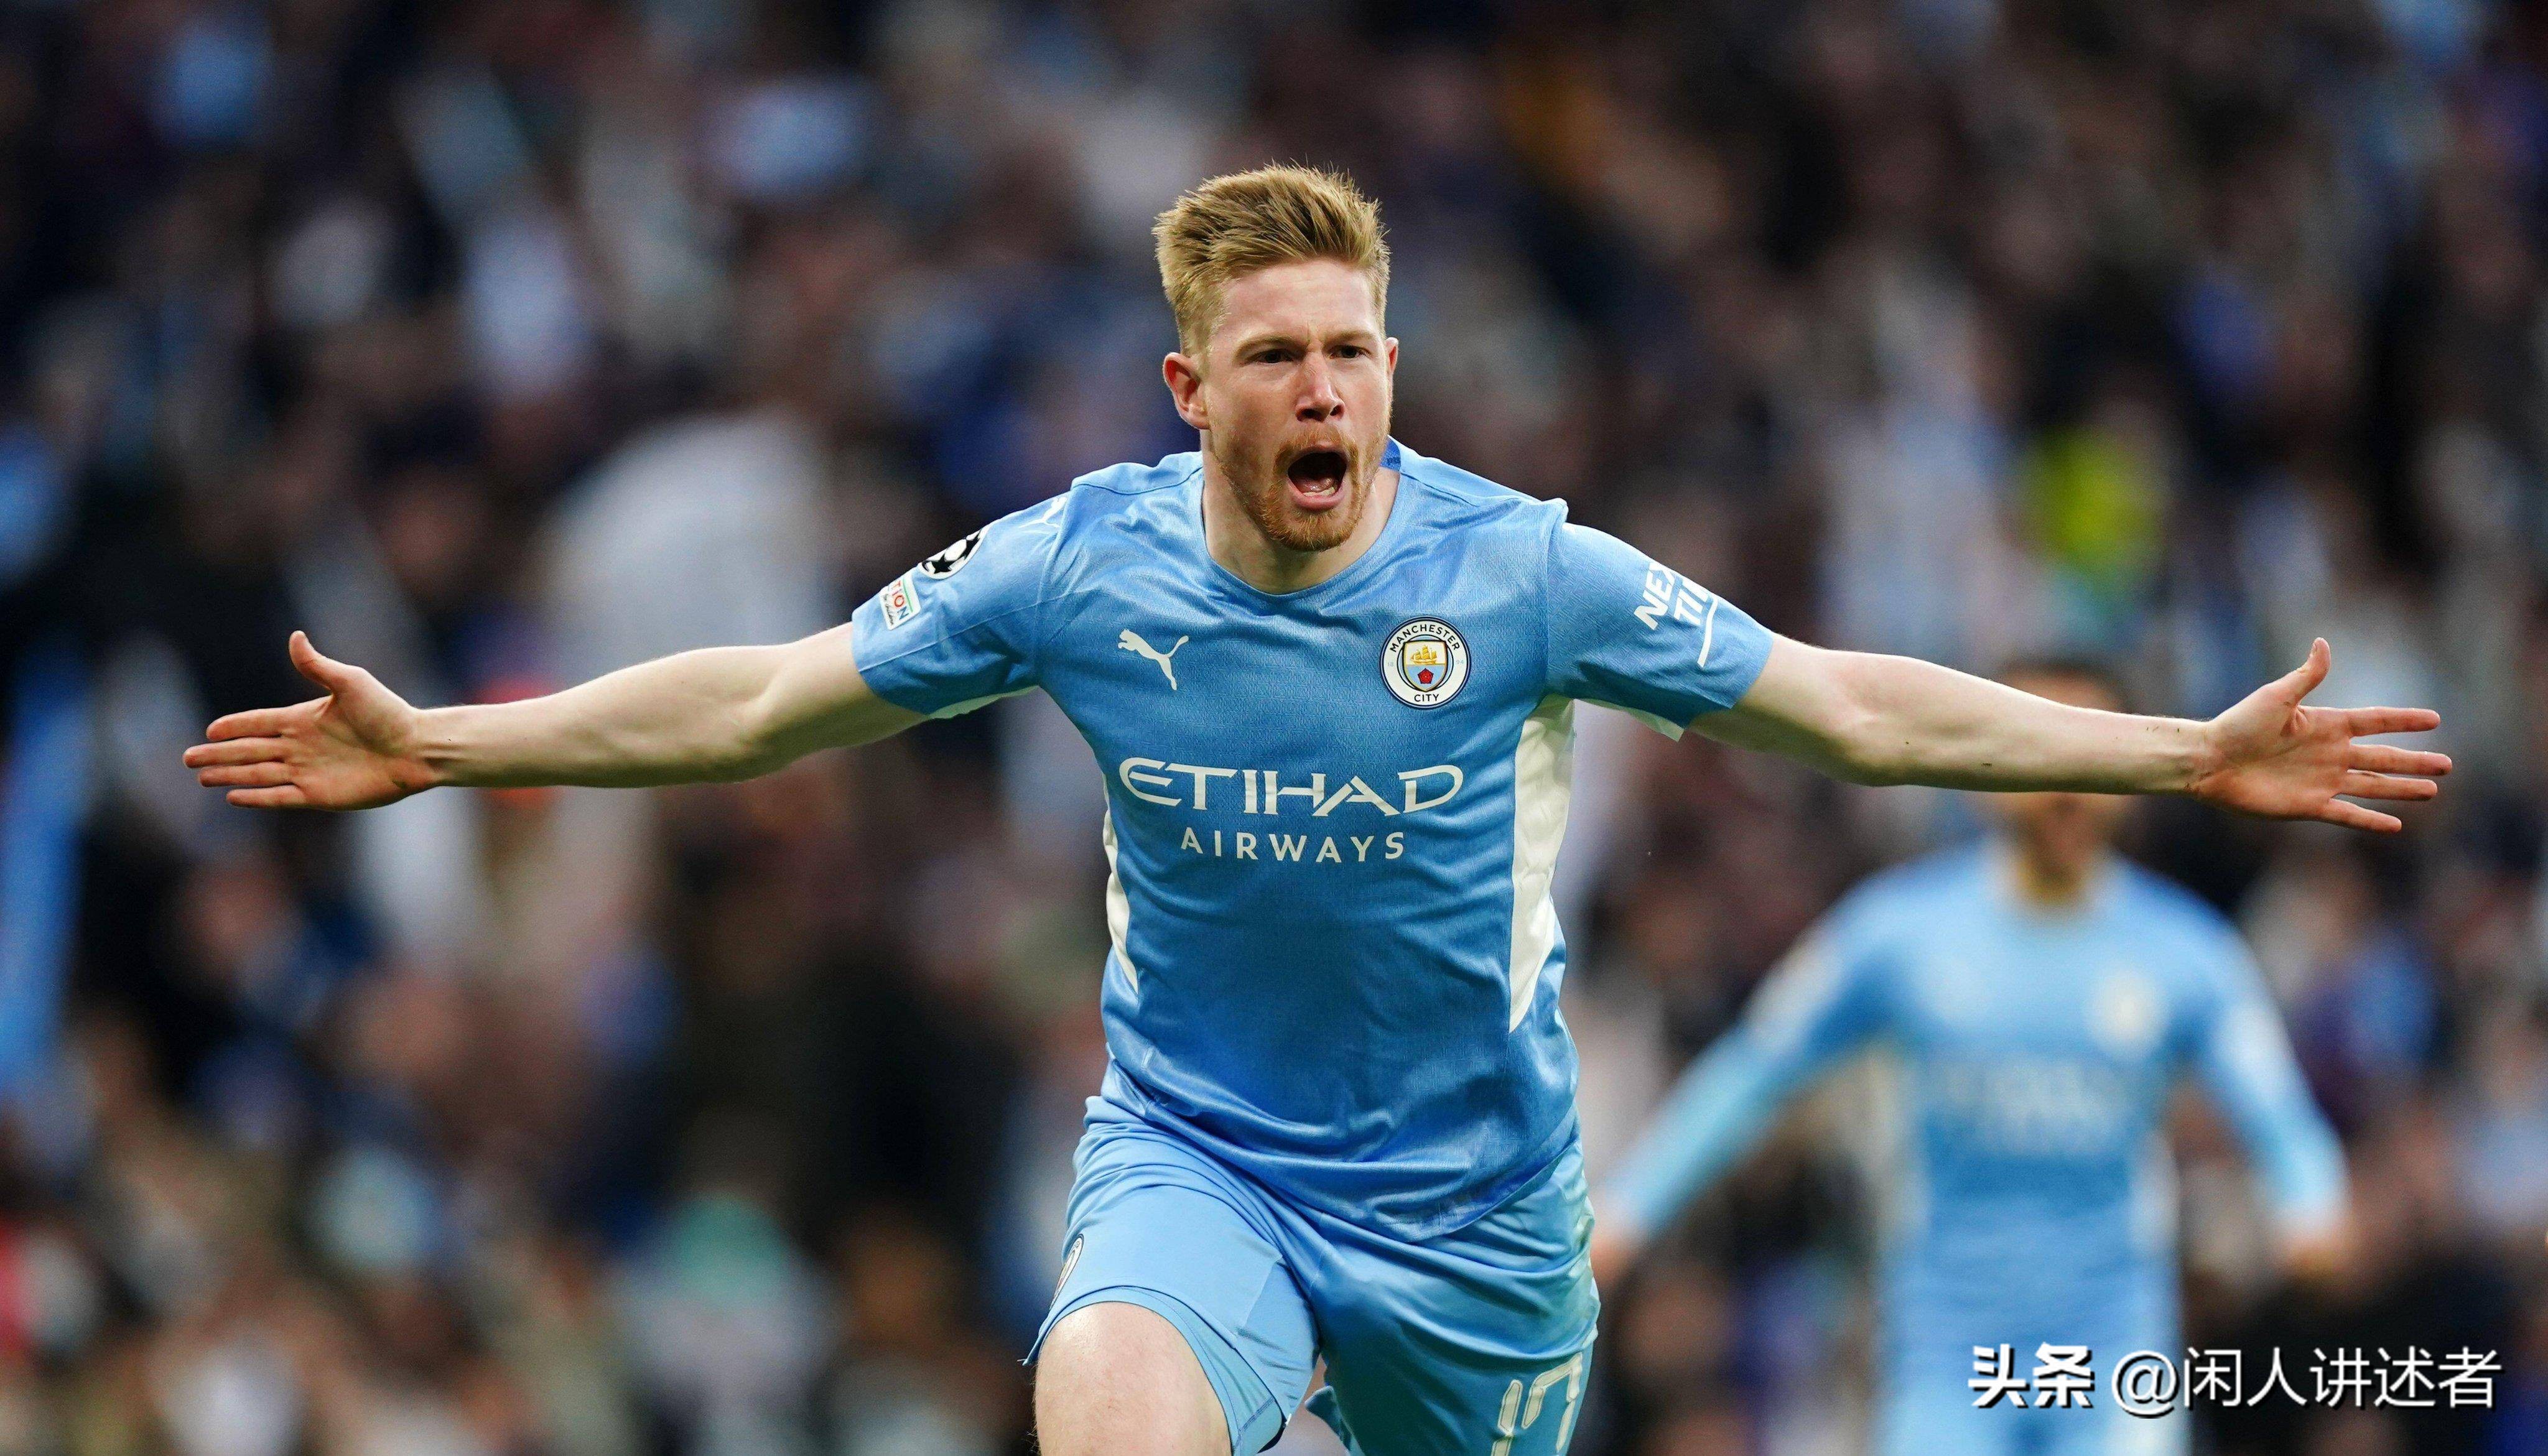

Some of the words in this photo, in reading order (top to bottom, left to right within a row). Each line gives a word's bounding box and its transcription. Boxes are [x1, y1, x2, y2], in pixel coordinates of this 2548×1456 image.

[1390, 624, 1460, 652] MANCHESTER
[1414, 693, 1439, 702] CITY
[1119, 757, 1464, 817] ETIHAD
[1181, 827, 1404, 863] AIRWAYS
[1491, 1352, 1583, 1456] 17
